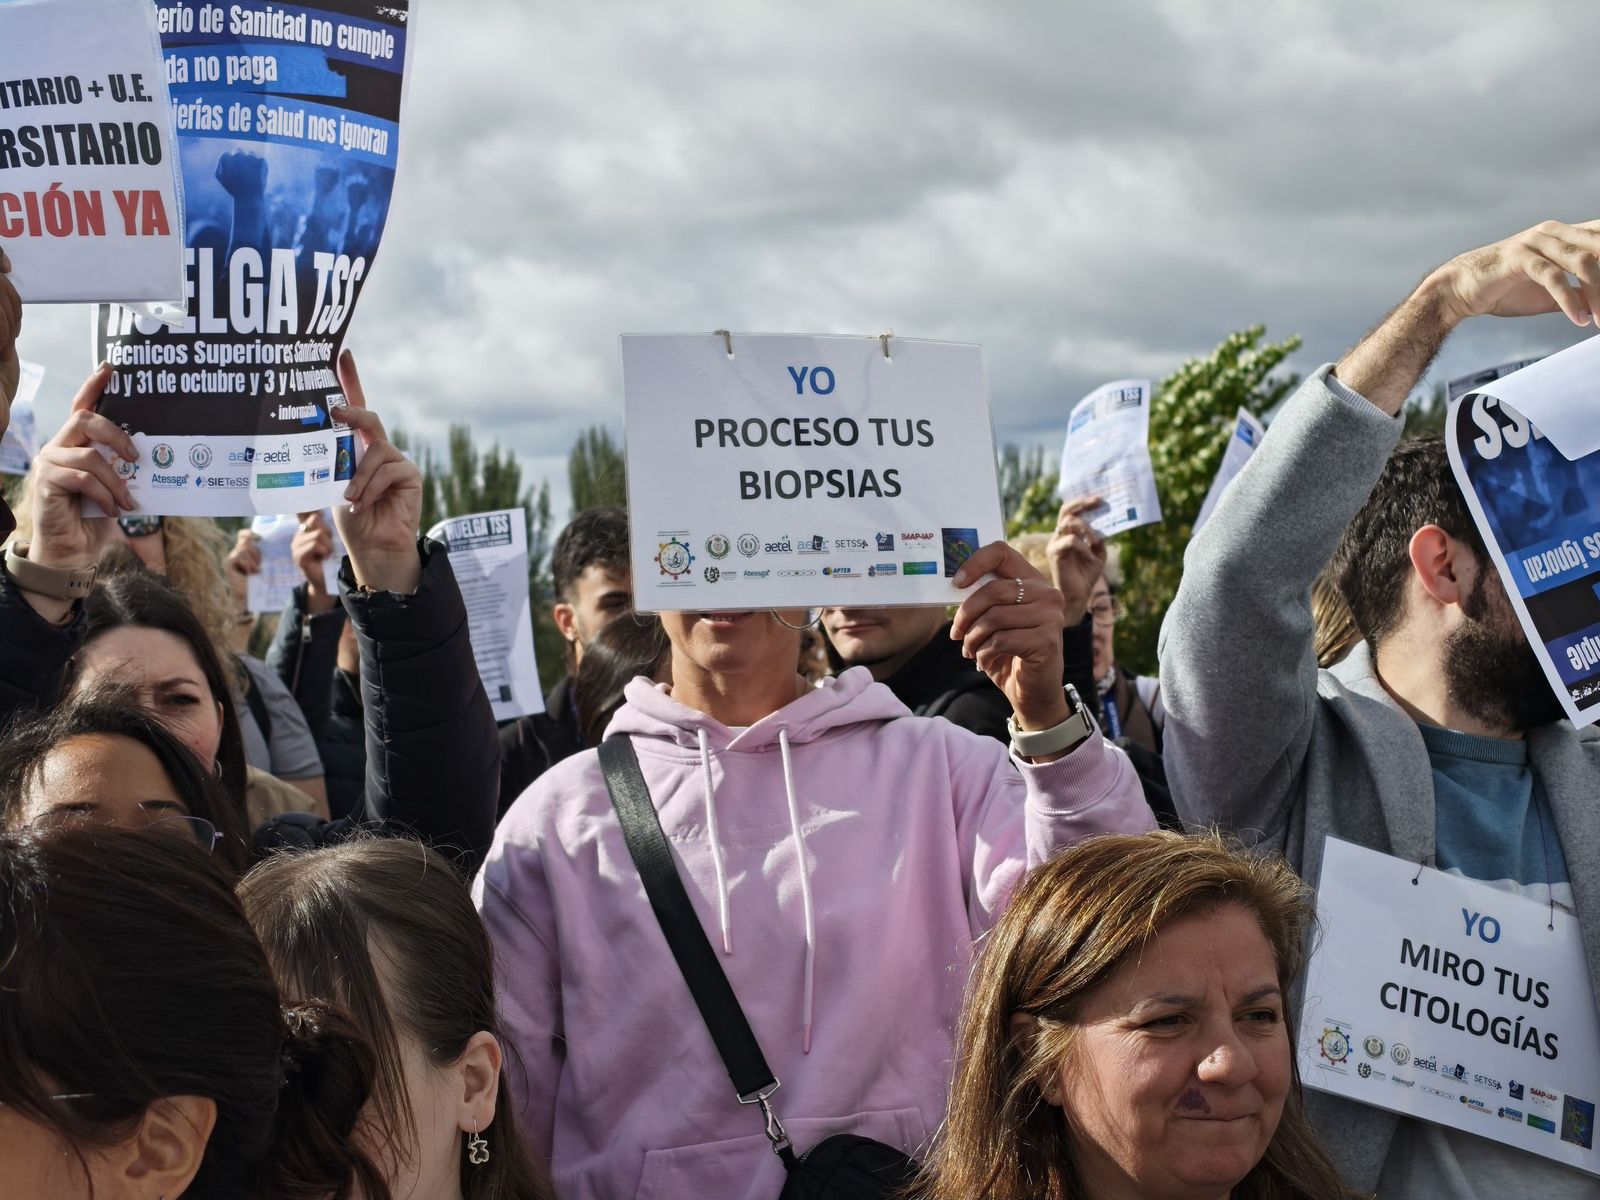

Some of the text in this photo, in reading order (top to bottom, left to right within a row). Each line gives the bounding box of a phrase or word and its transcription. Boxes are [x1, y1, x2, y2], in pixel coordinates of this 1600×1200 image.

[200, 4, 224, 33] de
[230, 6, 306, 43] Sanidad
[311, 19, 332, 46] no
[337, 24, 394, 59] cumple
[165, 55, 278, 84] da no paga
[108, 73, 153, 102] U.E.
[228, 102, 251, 131] de
[256, 104, 304, 139] Salud
[308, 114, 336, 144] nos
[340, 115, 388, 155] ignoran
[0, 121, 162, 169] RSITARIO
[0, 182, 170, 238] CIÓN YA
[306, 251, 366, 335] TSS
[107, 340, 188, 366] Técnicos
[194, 340, 293, 366] Superiores
[123, 371, 132, 397] y
[136, 371, 153, 394] 31
[157, 370, 176, 392] de
[181, 370, 245, 394] octubre
[249, 372, 260, 396] y
[264, 371, 275, 392] 3
[278, 371, 288, 396] y
[289, 368, 296, 392] 4
[787, 366, 836, 396] YO
[695, 417, 935, 448] PROCESO TUS
[263, 448, 291, 462] aetel
[152, 473, 187, 486] Atessga
[207, 477, 249, 487] SIETeSS
[739, 468, 902, 500] BIOPSIAS
[489, 515, 509, 535] TSS
[764, 539, 793, 553] aetel
[1523, 539, 1589, 583] ignoran
[1461, 908, 1501, 943] YO
[1400, 938, 1550, 1009] MIRO TUS
[1380, 982, 1559, 1060] CITOLOGÍAS
[1413, 1056, 1437, 1072] aetel
